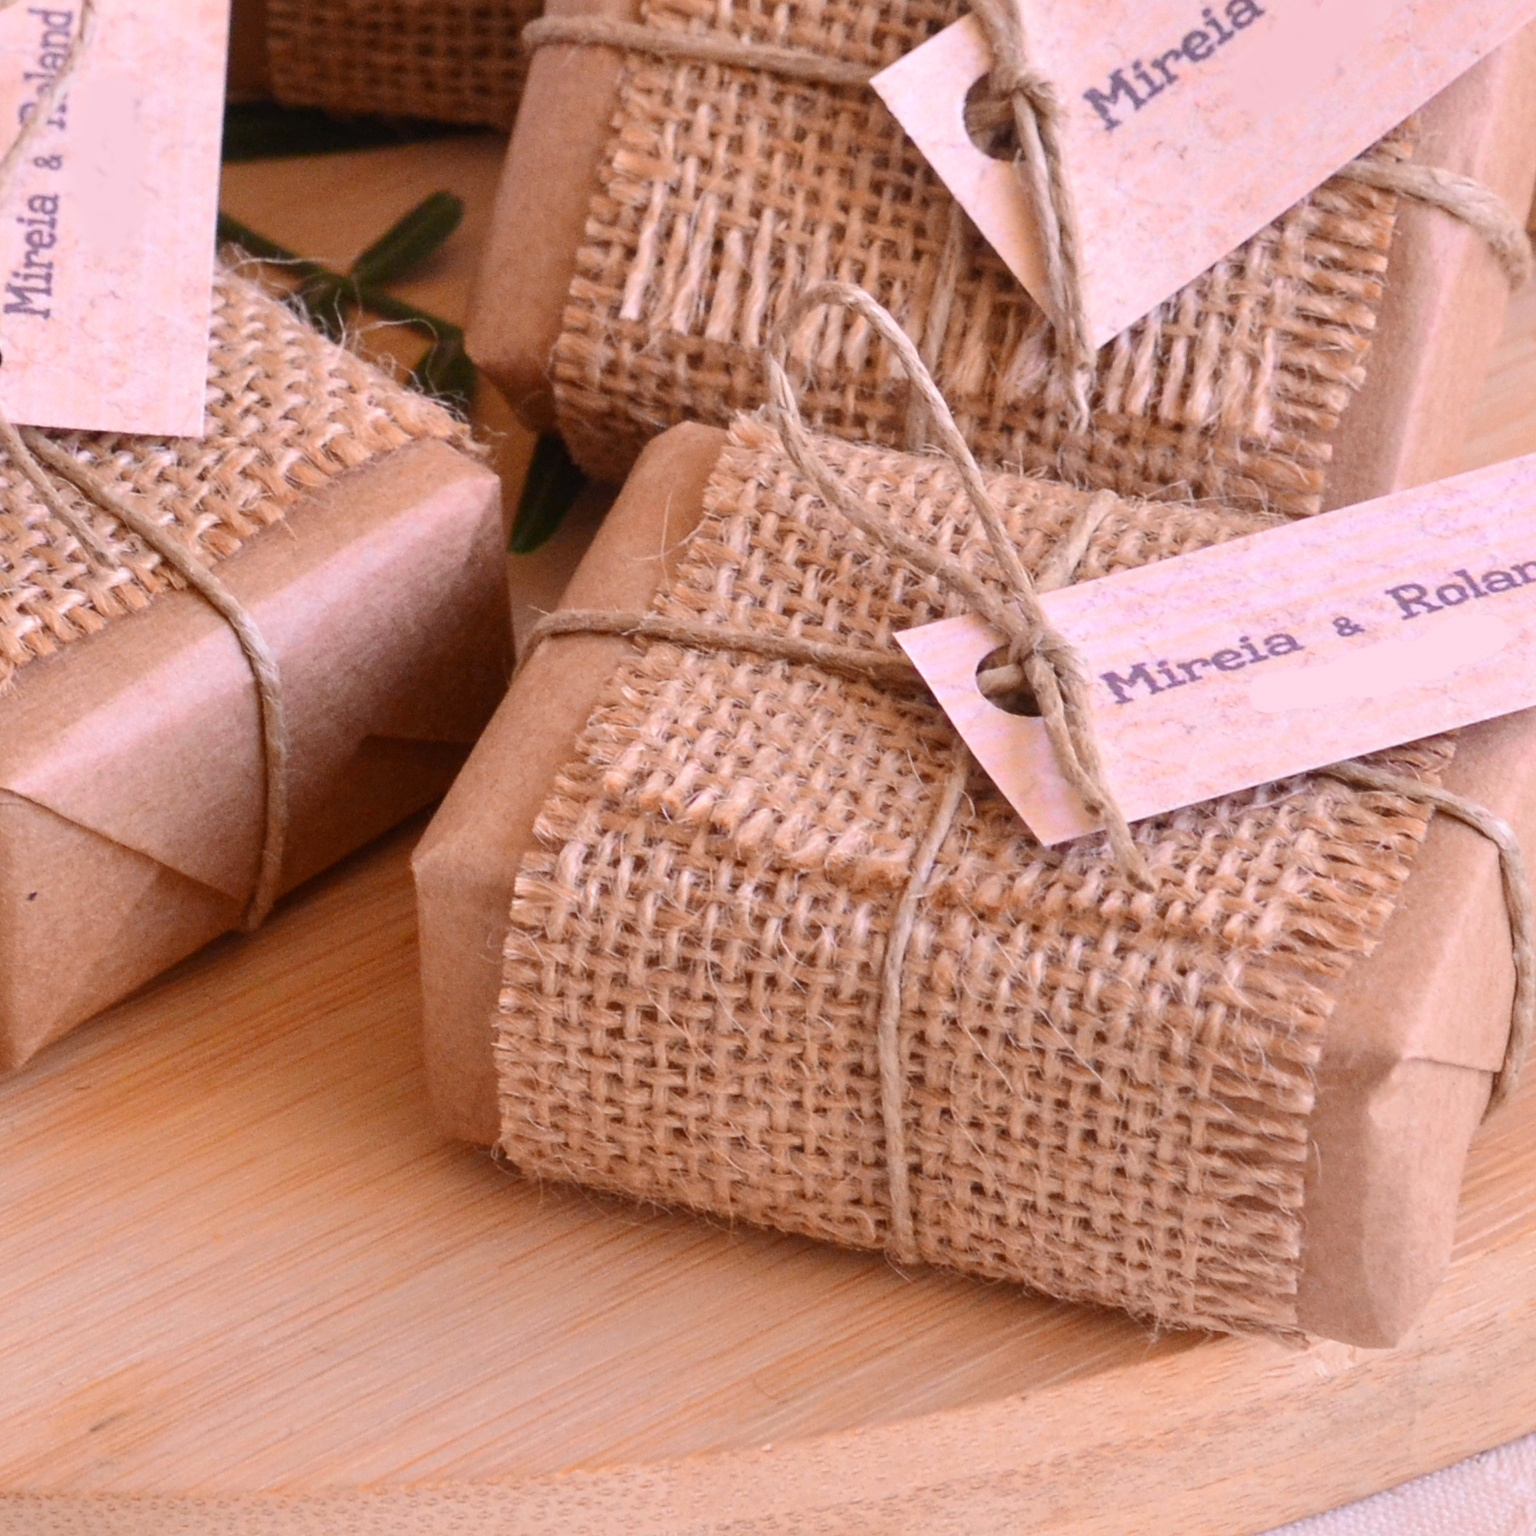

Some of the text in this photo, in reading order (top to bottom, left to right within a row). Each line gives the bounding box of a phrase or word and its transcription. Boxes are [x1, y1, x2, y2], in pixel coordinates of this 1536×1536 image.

[4, 193, 60, 319] Mireia
[33, 155, 63, 171] &
[1101, 627, 1300, 705] Mireia
[1333, 614, 1365, 638] &
